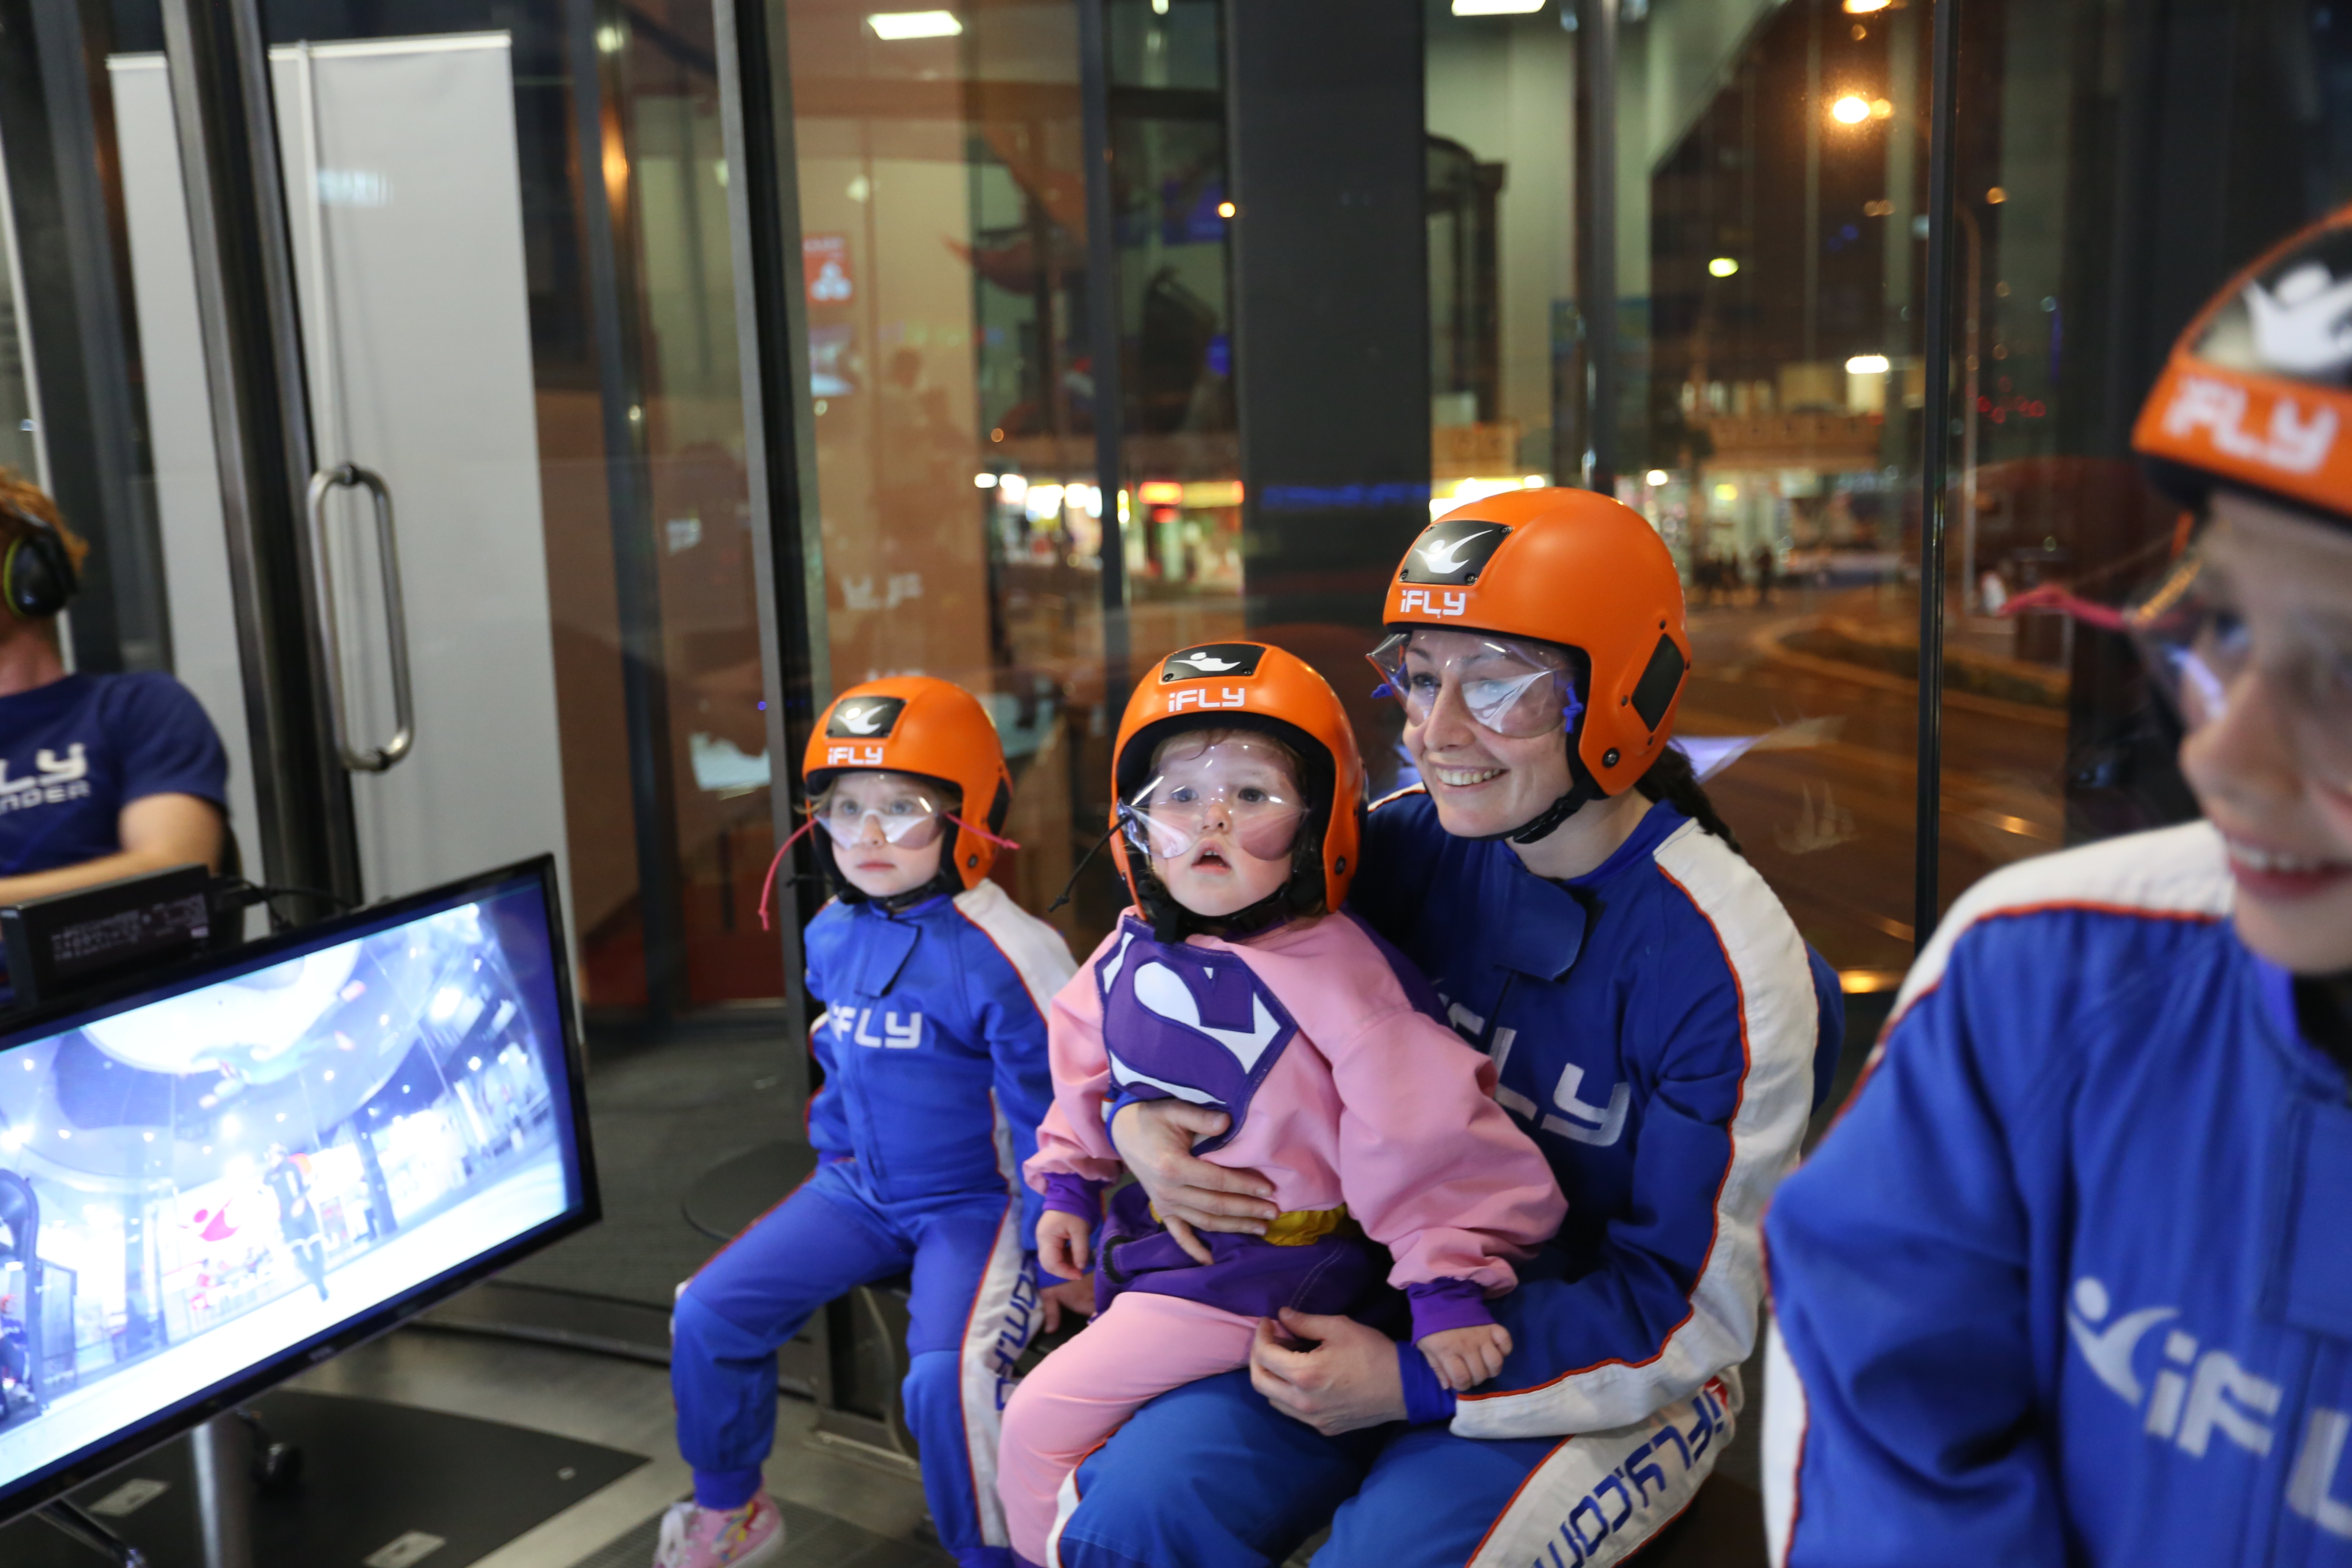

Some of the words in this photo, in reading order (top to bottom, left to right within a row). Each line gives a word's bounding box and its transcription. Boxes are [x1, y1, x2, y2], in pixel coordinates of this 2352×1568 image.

[1400, 590, 1466, 619] iFLY
[1168, 687, 1245, 712] iFLY
[828, 746, 883, 765] iFLY
